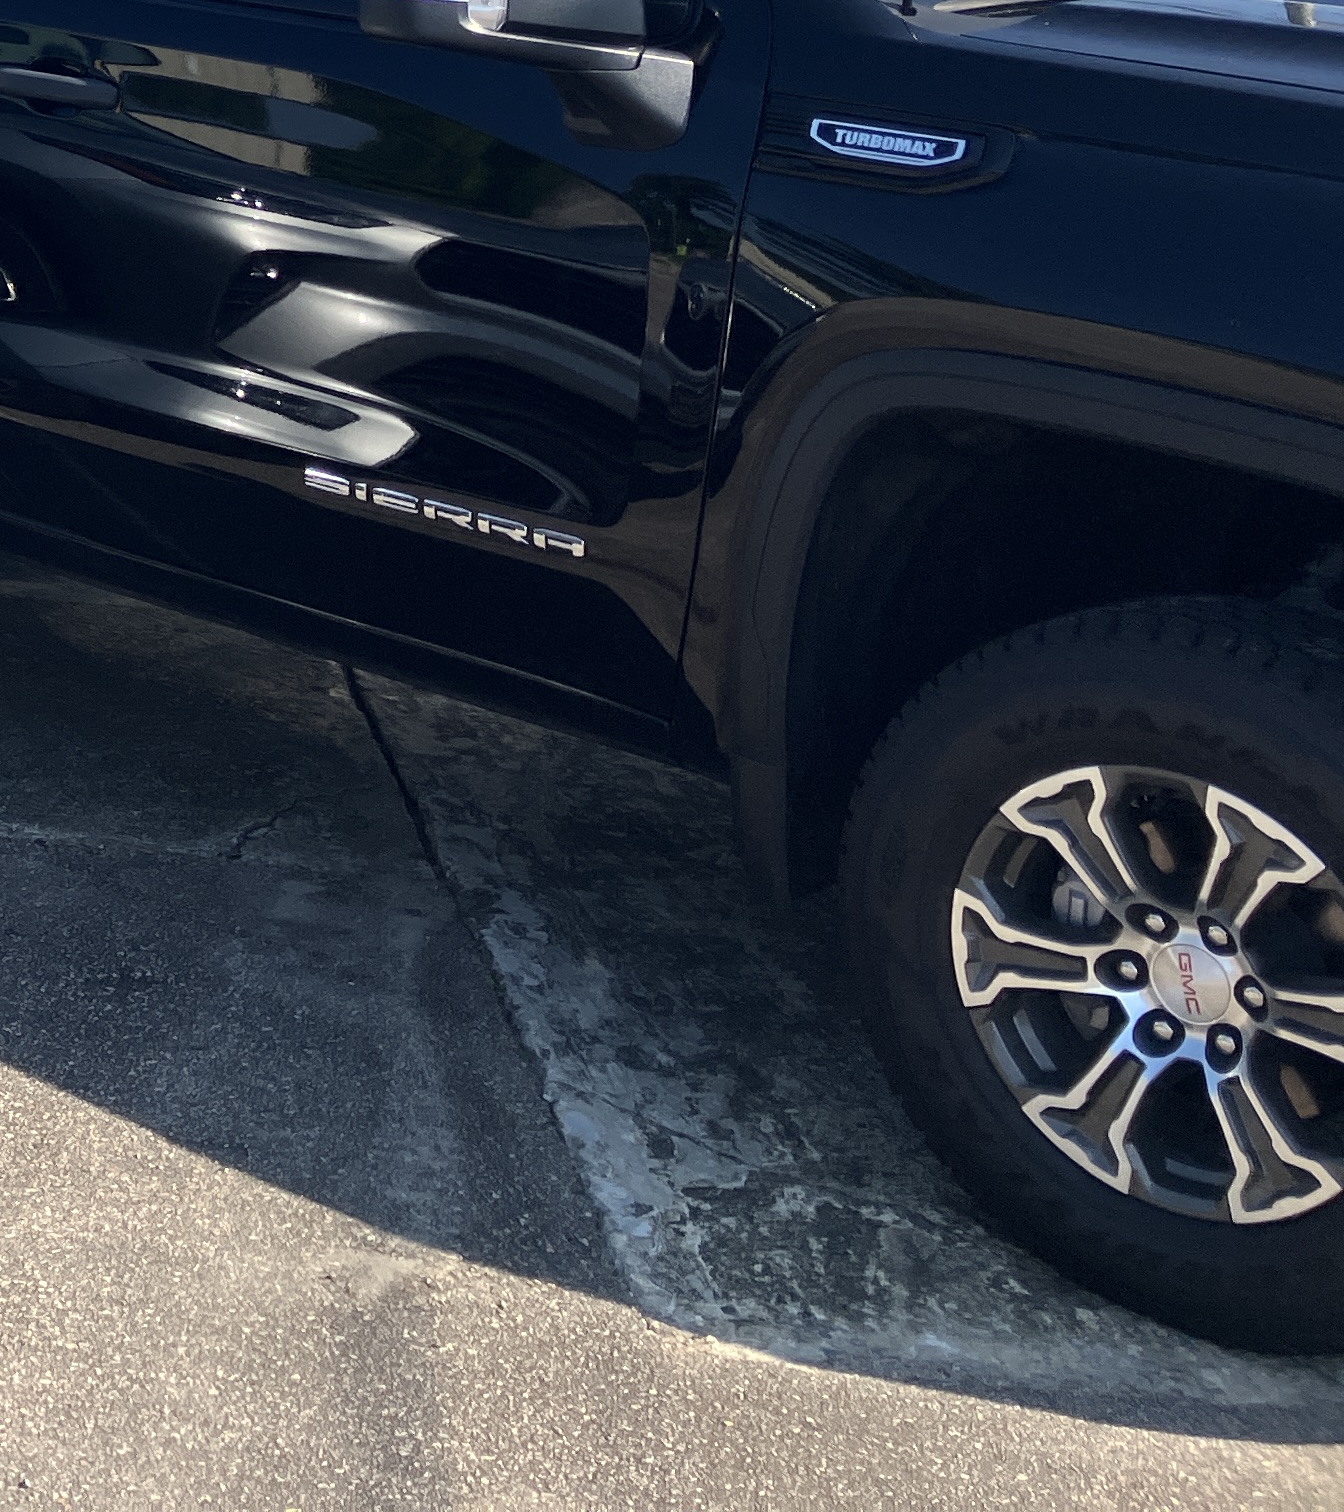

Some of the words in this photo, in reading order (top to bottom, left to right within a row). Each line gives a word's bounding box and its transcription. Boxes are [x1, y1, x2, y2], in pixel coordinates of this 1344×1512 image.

[835, 129, 937, 157] TURBOMAX
[304, 466, 585, 557] SIERRA
[1178, 953, 1201, 1015] GMC
